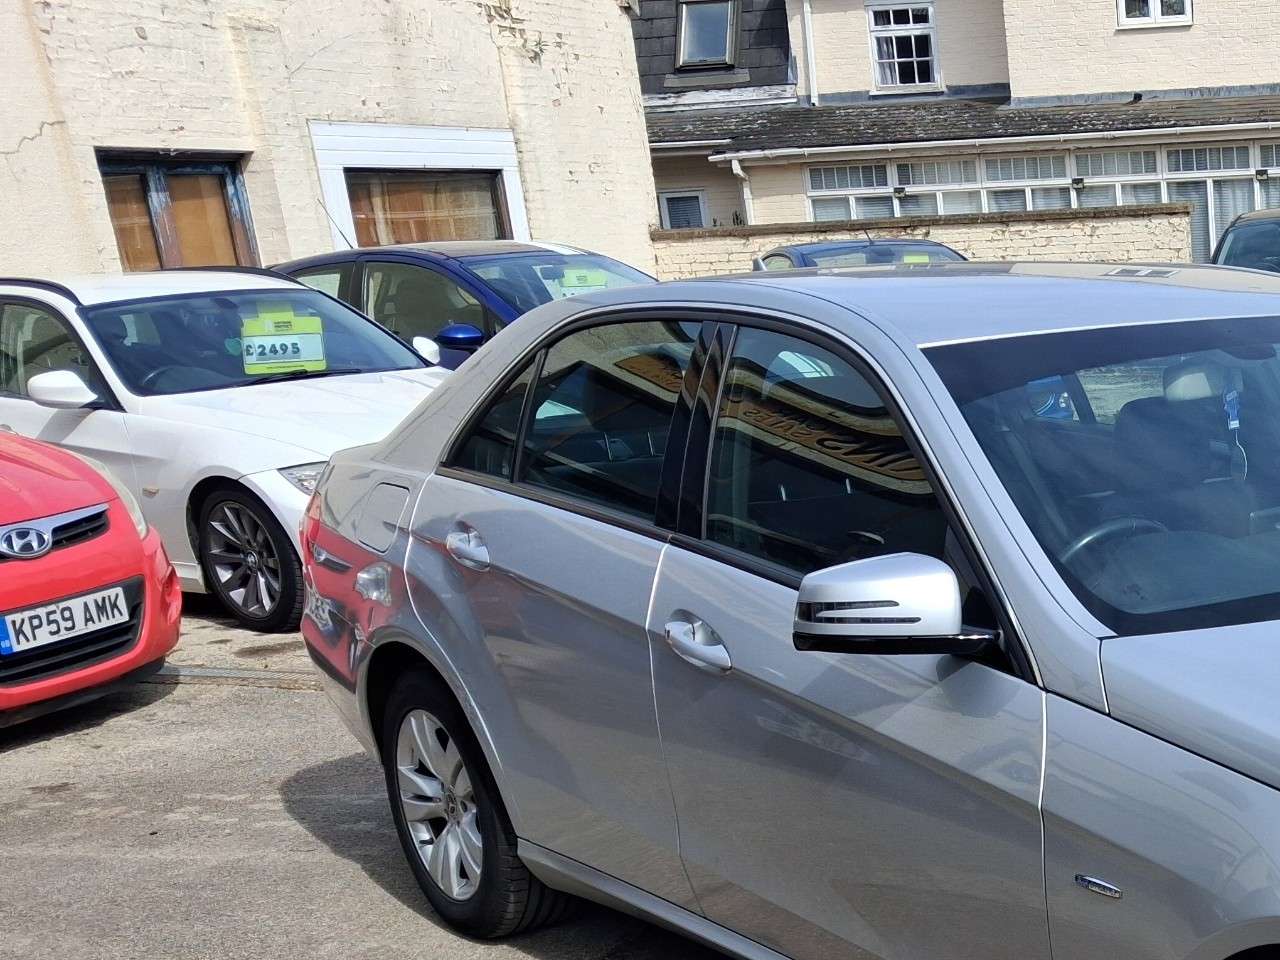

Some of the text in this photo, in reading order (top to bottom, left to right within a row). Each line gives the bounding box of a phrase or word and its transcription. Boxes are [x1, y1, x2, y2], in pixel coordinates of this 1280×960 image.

[245, 342, 300, 357] £2495
[11, 593, 124, 645] KP59 AMK
